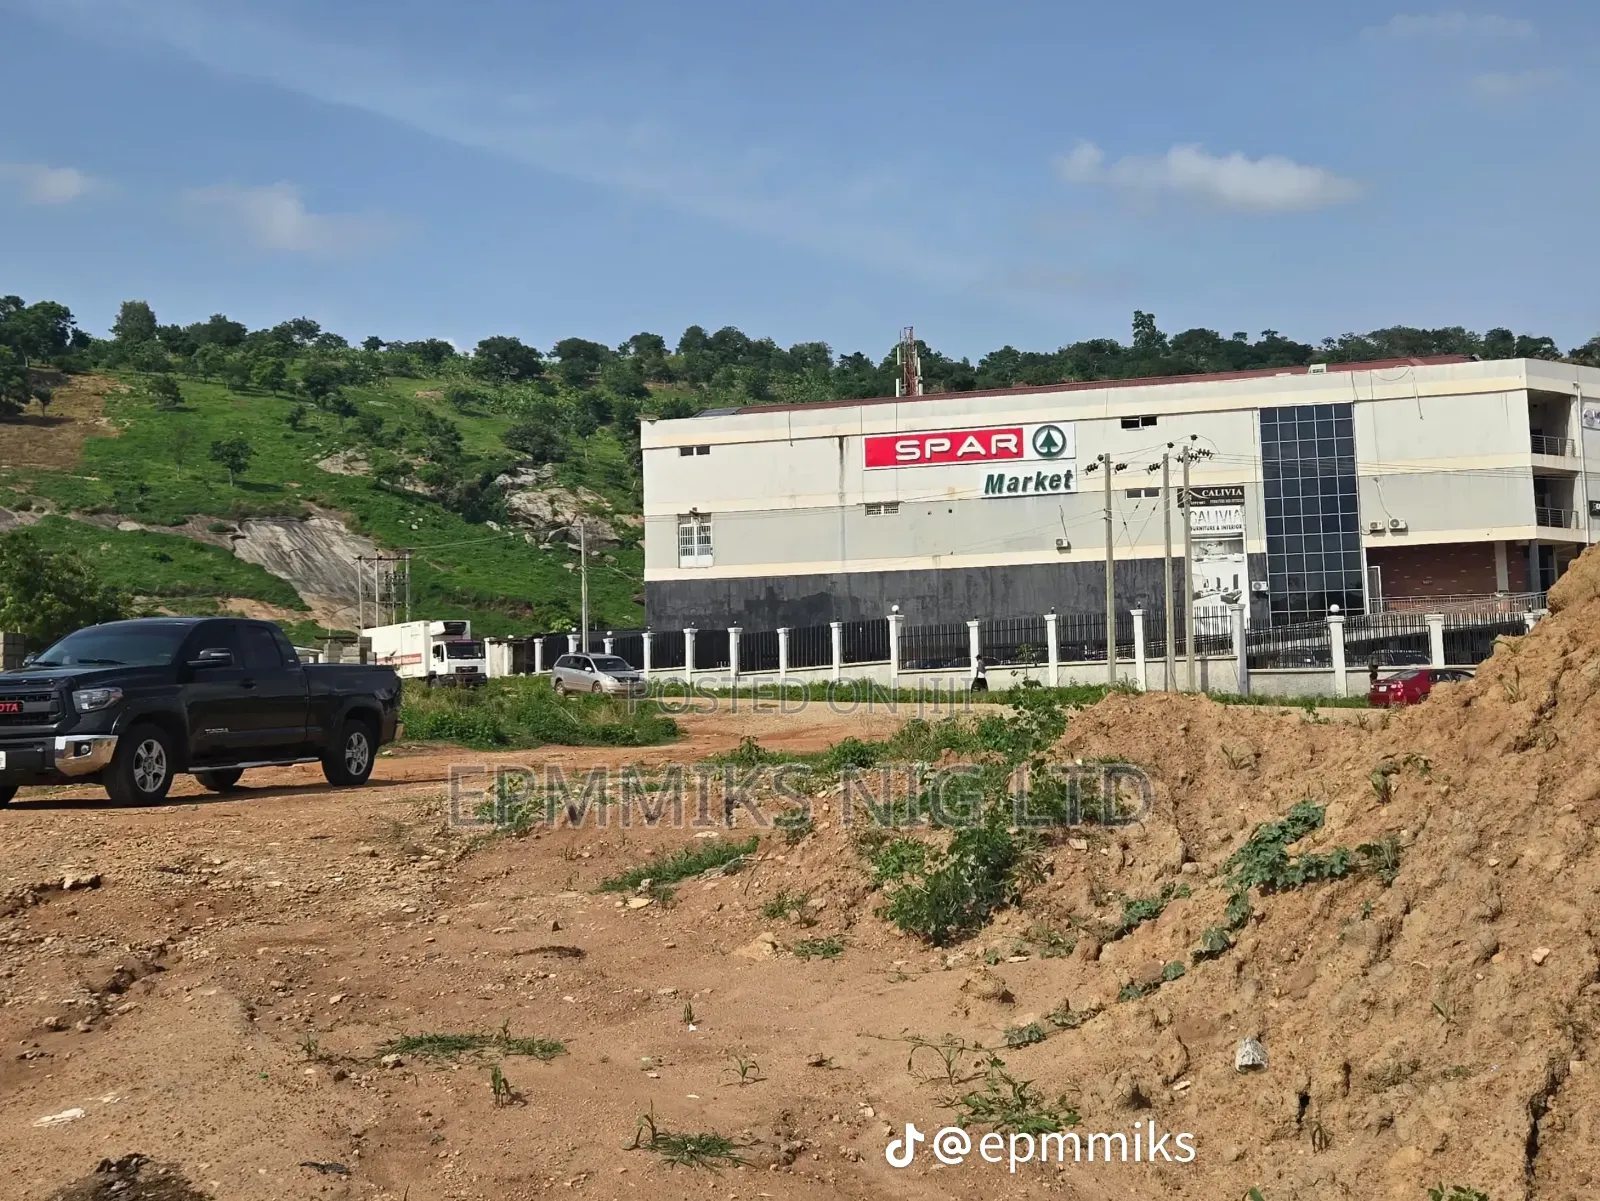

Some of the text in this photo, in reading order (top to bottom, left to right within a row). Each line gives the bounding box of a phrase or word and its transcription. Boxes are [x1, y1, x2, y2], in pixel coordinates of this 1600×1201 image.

[895, 433, 1018, 460] SPAR
[984, 469, 1073, 494] Market
[1201, 488, 1242, 497] CALIVIA
